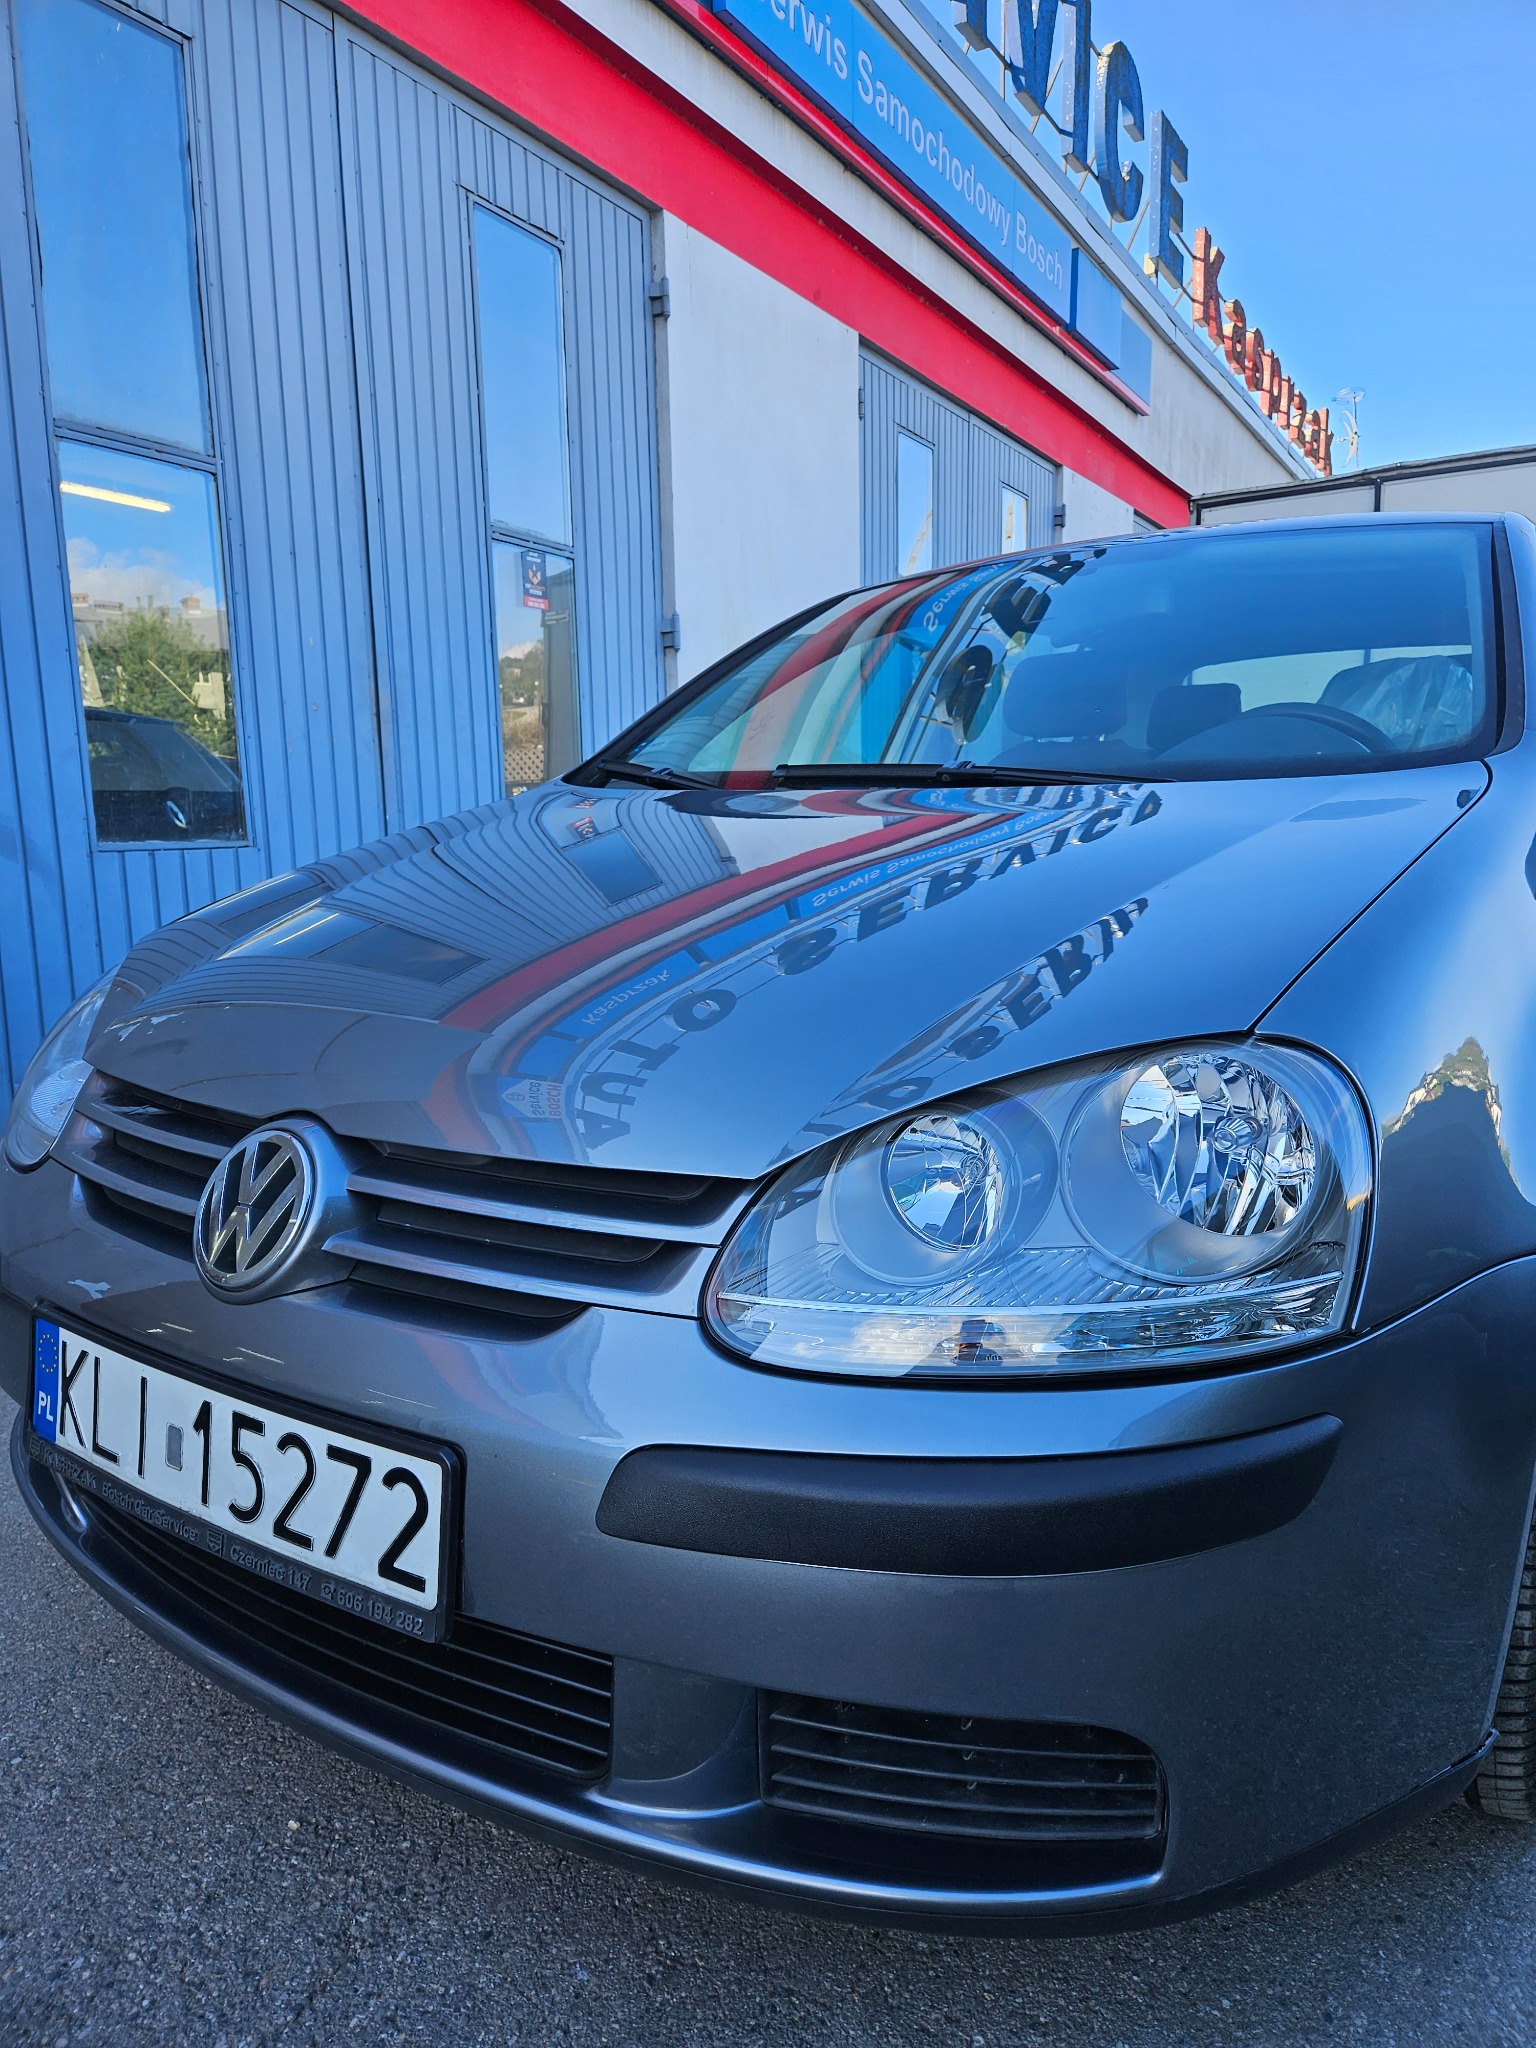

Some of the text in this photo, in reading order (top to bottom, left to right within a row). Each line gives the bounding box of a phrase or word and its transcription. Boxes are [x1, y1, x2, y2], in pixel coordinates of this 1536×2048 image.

[857, 50, 1011, 248] Samochodowy
[1016, 210, 1063, 291] Bosch
[954, 0, 1189, 289] VICE
[38, 1390, 54, 1422] PL
[59, 1340, 428, 1593] KLI 15272
[102, 1481, 132, 1510] Bosch
[134, 1499, 155, 1520] Car
[154, 1508, 198, 1541] Service
[230, 1544, 424, 1636] Czerniec 147 606 194 282
